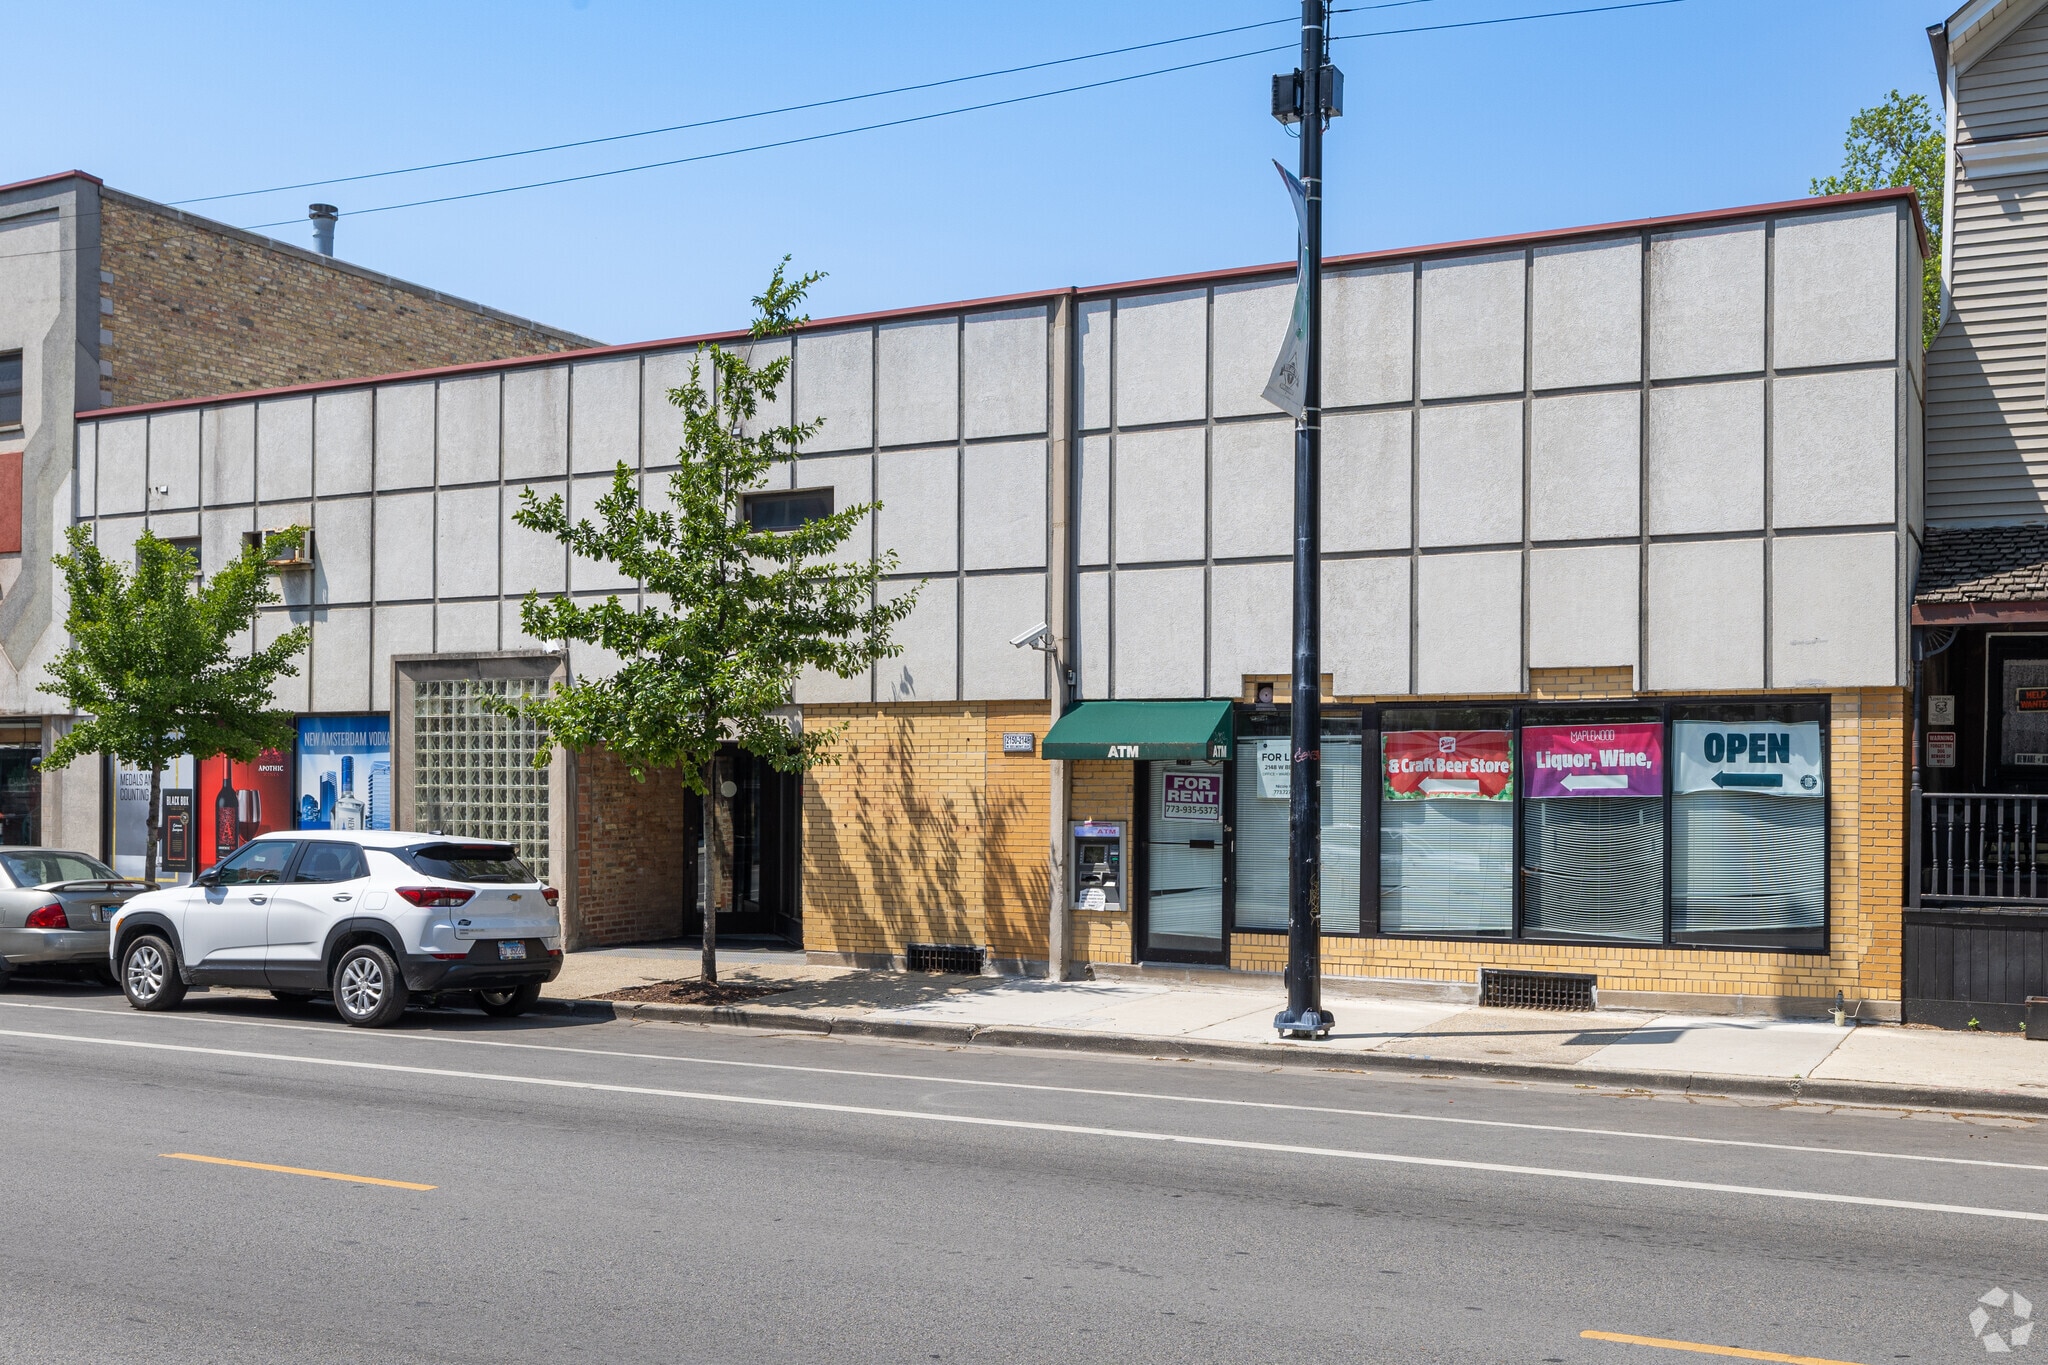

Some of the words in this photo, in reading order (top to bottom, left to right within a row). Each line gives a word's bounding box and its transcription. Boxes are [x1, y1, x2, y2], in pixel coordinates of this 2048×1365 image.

[2026, 691, 2047, 699] HELP
[2020, 701, 2048, 709] WANTE
[304, 732, 320, 747] NEW
[321, 732, 366, 746] AMSTERDAM
[368, 731, 390, 746] VODKA
[1570, 729, 1615, 744] MAPLEWOOD
[1107, 745, 1139, 758] ATM
[1212, 745, 1227, 758] ATM
[1703, 732, 1790, 764] OPEN
[1262, 753, 1281, 761] FOR
[1536, 751, 1597, 771] Liquor,
[1599, 749, 1652, 769] Wine,
[1388, 759, 1400, 773] &
[1401, 758, 1435, 773] Craft
[1436, 759, 1469, 773] Beer
[1470, 759, 1510, 773] Store
[120, 773, 143, 787] MEDALS
[1173, 777, 1211, 790] FOR
[119, 788, 149, 801] COUNTING
[166, 795, 180, 806] BLACK
[180, 795, 189, 806] BOX
[1167, 789, 1217, 803] RENT
[1165, 804, 1218, 815] 773-935-5373
